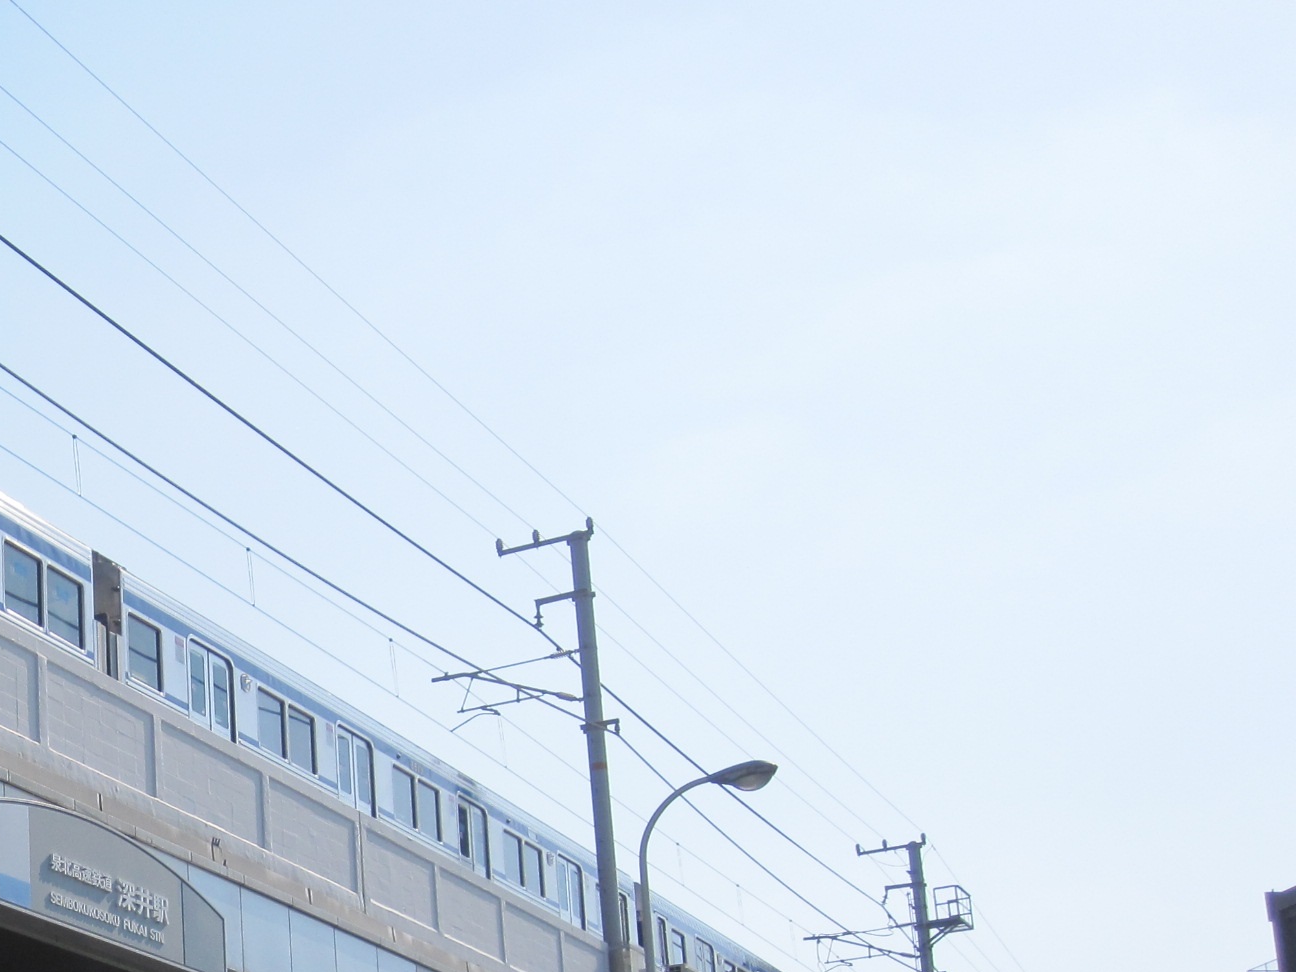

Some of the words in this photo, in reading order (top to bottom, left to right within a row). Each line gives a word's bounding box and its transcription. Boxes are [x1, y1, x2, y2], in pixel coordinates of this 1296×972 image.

[50, 891, 120, 927] SEMBOKUKOSOKU
[123, 919, 148, 938] FUKAI
[149, 928, 165, 944] STN
[51, 853, 112, 892] 泉北高速鉄道
[117, 877, 169, 925] 深井駅
